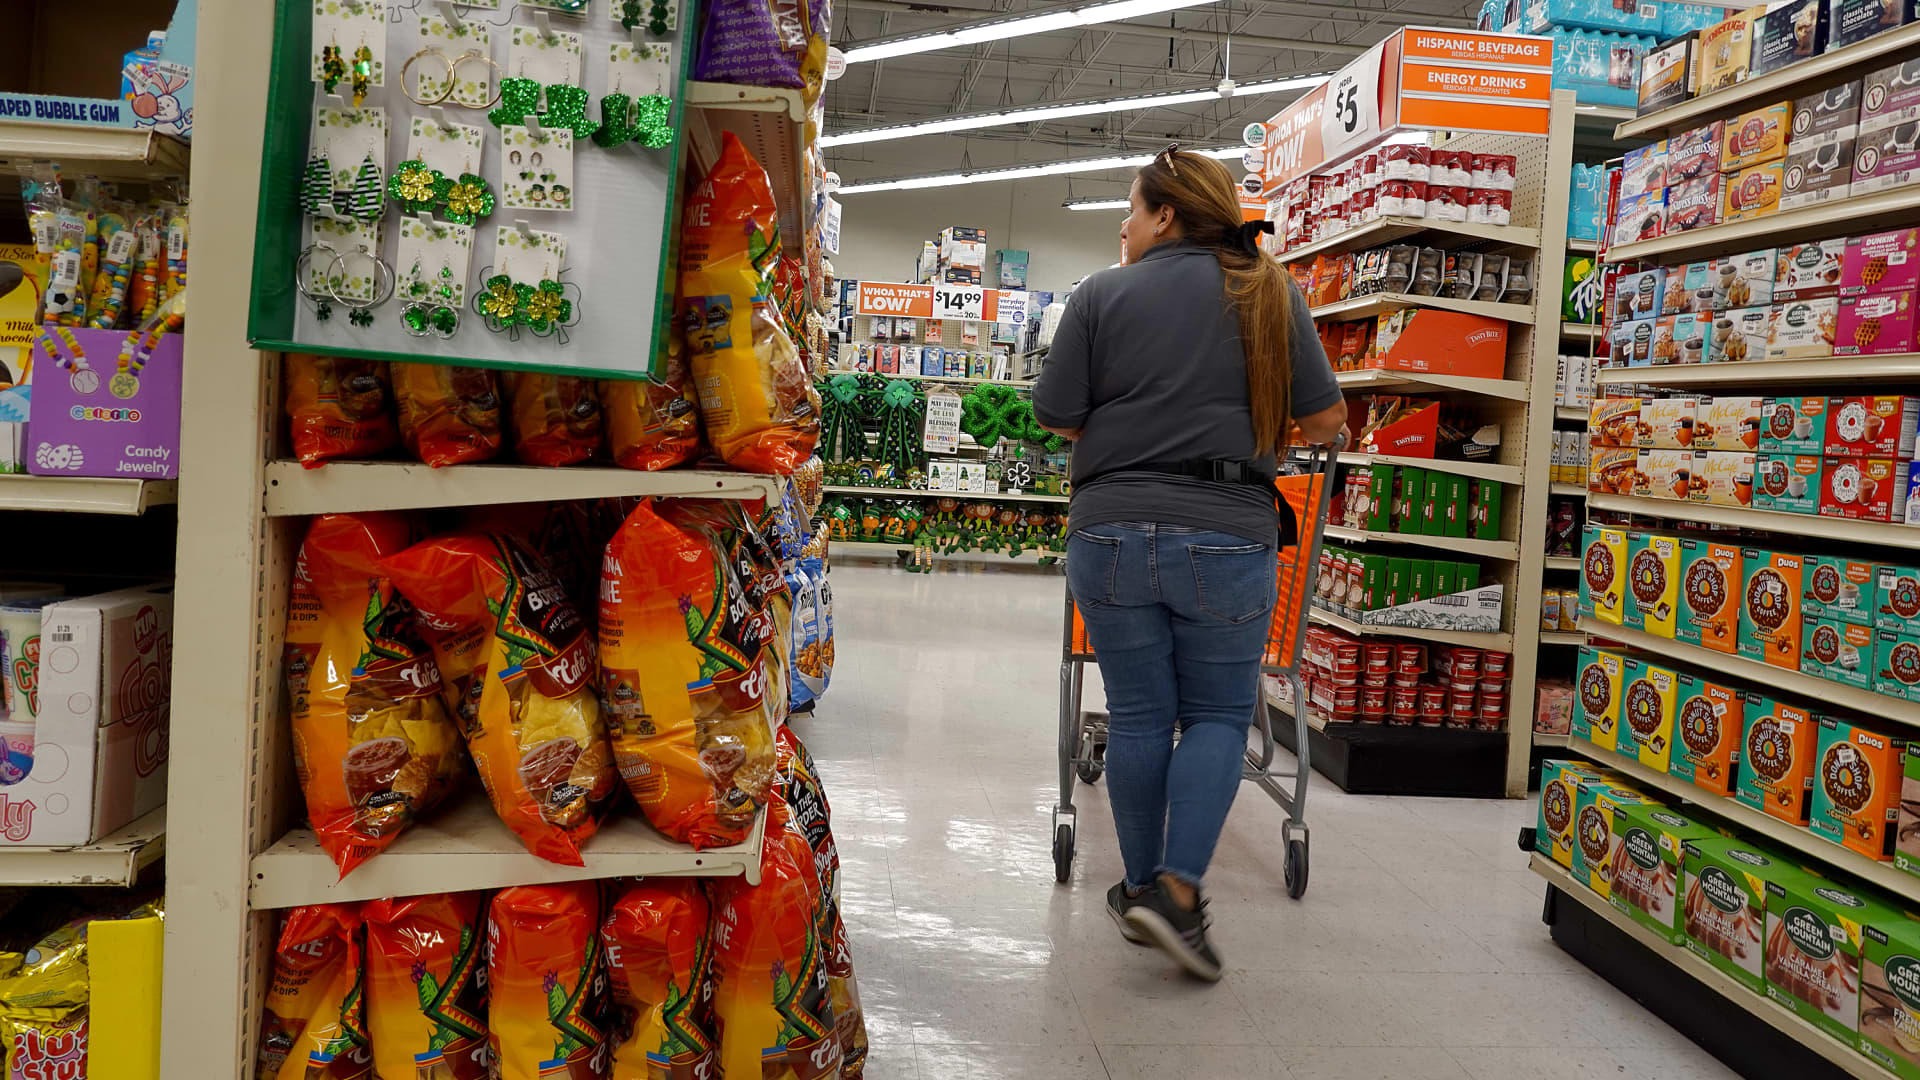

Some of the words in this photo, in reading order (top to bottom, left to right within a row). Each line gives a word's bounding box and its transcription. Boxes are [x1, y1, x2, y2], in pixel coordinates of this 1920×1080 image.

[1417, 37, 1474, 51] HISPANIC
[1478, 42, 1540, 56] BEVERAGE
[1476, 53, 1505, 61] HISPANAS
[1428, 72, 1476, 85] ENERGY
[1480, 76, 1526, 88] DRINKS
[1442, 84, 1466, 92] BEBIDAS
[1468, 86, 1510, 95] ENERGIZANTES
[36, 102, 88, 120] BUBBLE
[90, 106, 120, 123] GUM
[1336, 84, 1358, 133] $5
[1268, 122, 1292, 149] WHOA
[1294, 98, 1324, 132] THAT'S
[1266, 130, 1306, 182] LOW!
[1802, 250, 1818, 258] GREEN
[864, 287, 896, 296] WHOA
[898, 289, 930, 299] THAT'S
[864, 296, 912, 314] LOW!
[1470, 332, 1486, 343] TASTY
[1486, 330, 1498, 338] BITE
[1396, 436, 1410, 446] TASTY
[126, 445, 170, 460] Candy
[116, 460, 170, 476] Jewelry
[1656, 540, 1674, 550] Duos
[1714, 548, 1734, 558] Duos
[1636, 560, 1650, 581] DONUT
[1778, 558, 1799, 569] Duos
[1692, 570, 1707, 592] DONUT
[1708, 570, 1719, 596] SHOP
[1694, 594, 1714, 604] COFFEE
[1756, 606, 1777, 616] COFFEE
[551, 646, 587, 684] Café
[400, 662, 440, 688] Café
[1652, 671, 1672, 684] Duos
[1710, 688, 1730, 701] Duos
[1632, 690, 1646, 710] DONUT
[1646, 694, 1656, 716] SHOP
[1687, 708, 1702, 729] DONUT
[1702, 710, 1714, 736] SHOP
[1782, 708, 1804, 723] Duos
[1690, 730, 1708, 743] COFFEE
[1858, 734, 1884, 749] Duos
[1754, 730, 1772, 752] DONUT
[1772, 731, 1784, 761] SHOP
[1756, 754, 1778, 768] COFFEE
[1850, 758, 1864, 790] SHOP
[1833, 782, 1857, 798] COFFEE
[1601, 800, 1614, 812] Duo
[1834, 802, 1852, 816] Nutty
[1812, 818, 1821, 829] 24
[1830, 810, 1857, 827] Caramel
[1631, 834, 1653, 852] GREEN
[1626, 840, 1658, 863] MOUNTAIN
[1896, 856, 1909, 870] 32
[1618, 870, 1640, 886] VANILLA
[1628, 866, 1652, 884] CARAMEL
[1708, 874, 1733, 894] GREEN
[1702, 881, 1739, 906] MOUNTAIN
[1695, 912, 1721, 932] VANILLA
[1704, 908, 1735, 931] CARAMEL
[1794, 916, 1824, 938] GREEN
[1786, 922, 1831, 953] MOUNTAIN
[1868, 928, 1887, 943] KEURIG
[1686, 938, 1695, 950] 32
[1778, 956, 1810, 981] VANILLA
[1790, 954, 1826, 980] CARAMEL
[280, 986, 298, 996] DIPS
[1767, 985, 1778, 999] 32
[1861, 1040, 1872, 1052] 32
